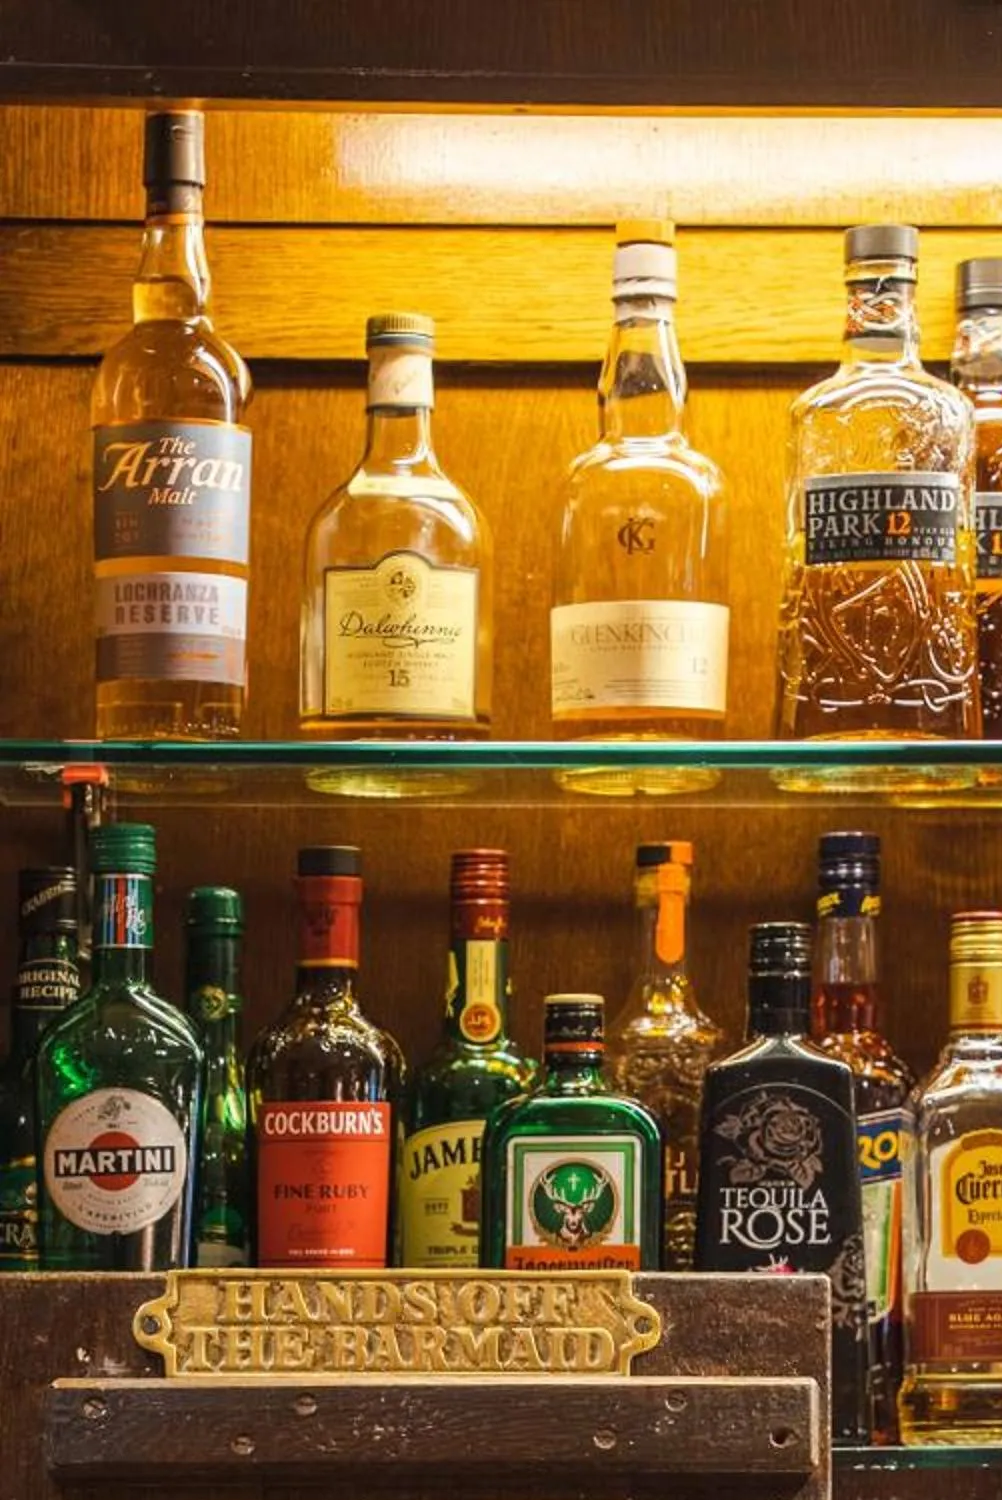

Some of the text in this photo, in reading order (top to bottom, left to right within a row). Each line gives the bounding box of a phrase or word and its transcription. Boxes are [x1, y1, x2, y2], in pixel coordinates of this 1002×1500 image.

[158, 435, 197, 455] The
[97, 440, 244, 492] Arran
[147, 486, 197, 505] Malt
[807, 488, 956, 516] HIGHLAND
[807, 512, 881, 540] PARK
[887, 511, 912, 536] 12
[114, 581, 220, 604] LOCHRANZA
[114, 603, 221, 626] RESERVE
[388, 668, 411, 688] 15
[264, 1108, 385, 1136] COCKBURN'S
[57, 1149, 172, 1175] MARTINI
[273, 1182, 369, 1200] FINE RUBY
[719, 1187, 828, 1211] TEQUILA
[719, 1208, 832, 1250] ROSE
[216, 1280, 574, 1323] HANDS OFF
[949, 1312, 982, 1323] BLUE
[185, 1325, 615, 1371] THE BARMAID
